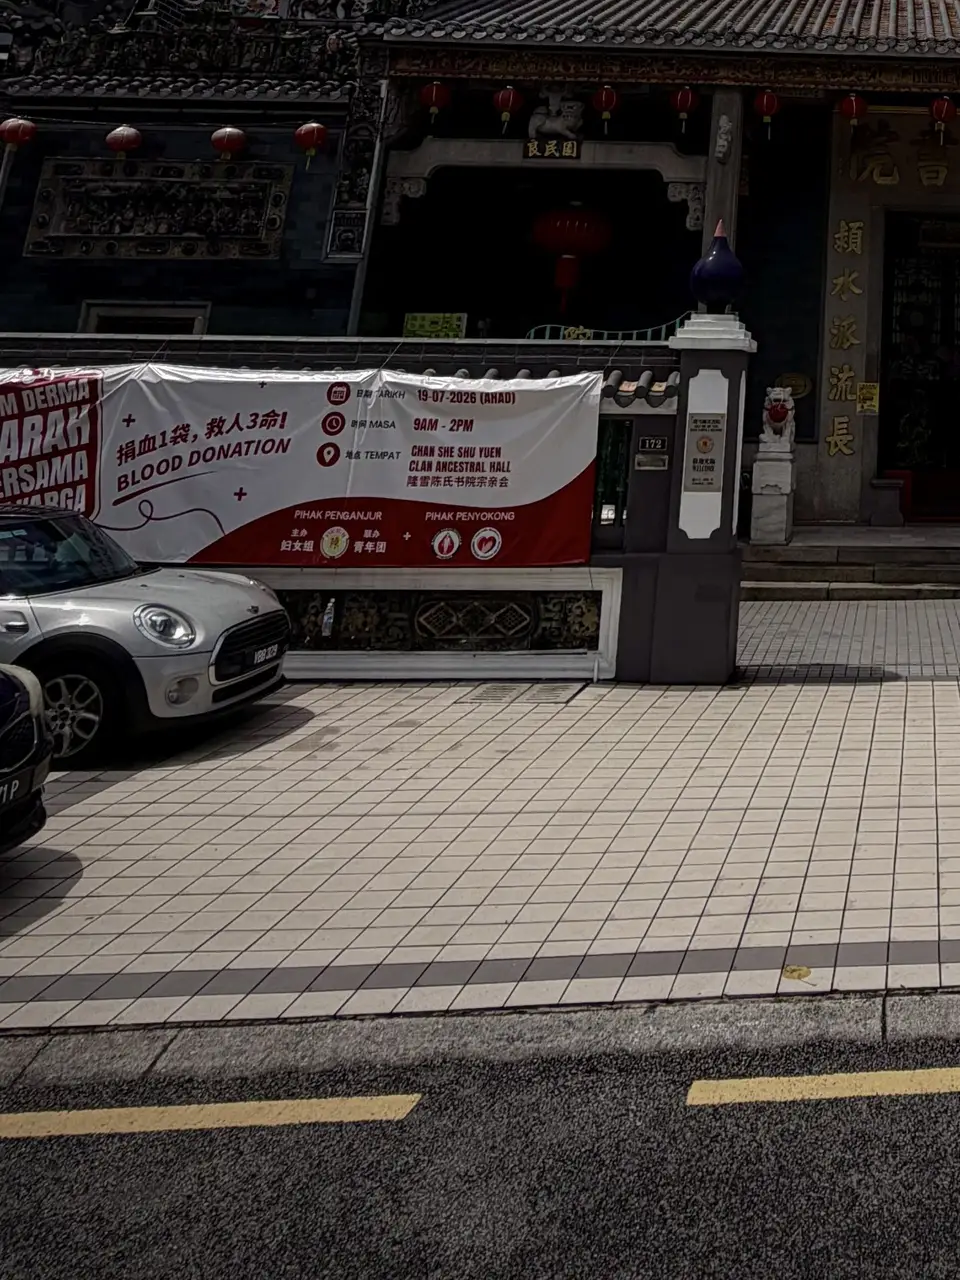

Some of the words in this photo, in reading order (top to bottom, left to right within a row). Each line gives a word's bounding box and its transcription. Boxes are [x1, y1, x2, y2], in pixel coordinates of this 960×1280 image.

[21, 378, 89, 412] DERMA
[417, 389, 476, 404] 19-07-2026
[480, 391, 516, 405] (AHAD)
[369, 420, 396, 429] MASA
[413, 418, 439, 431] 9AM
[448, 418, 474, 432] 2PM
[645, 439, 662, 449] 172
[365, 451, 401, 460] TEMPAT
[411, 445, 436, 457] CHAN
[438, 445, 455, 457] SHE
[457, 446, 476, 458] SHU
[479, 446, 502, 458] YUEN
[117, 455, 182, 492] BLOOD
[188, 438, 292, 467] DONATION
[408, 460, 433, 472] CLAN
[435, 460, 486, 473] ANCESTRAL
[489, 460, 511, 473] HALL
[294, 509, 322, 520] PIHAK
[324, 510, 382, 520] PENGANJUR
[425, 511, 454, 521] PIHAK
[456, 511, 515, 521] PENYOKONG
[10, 779, 20, 800] P
